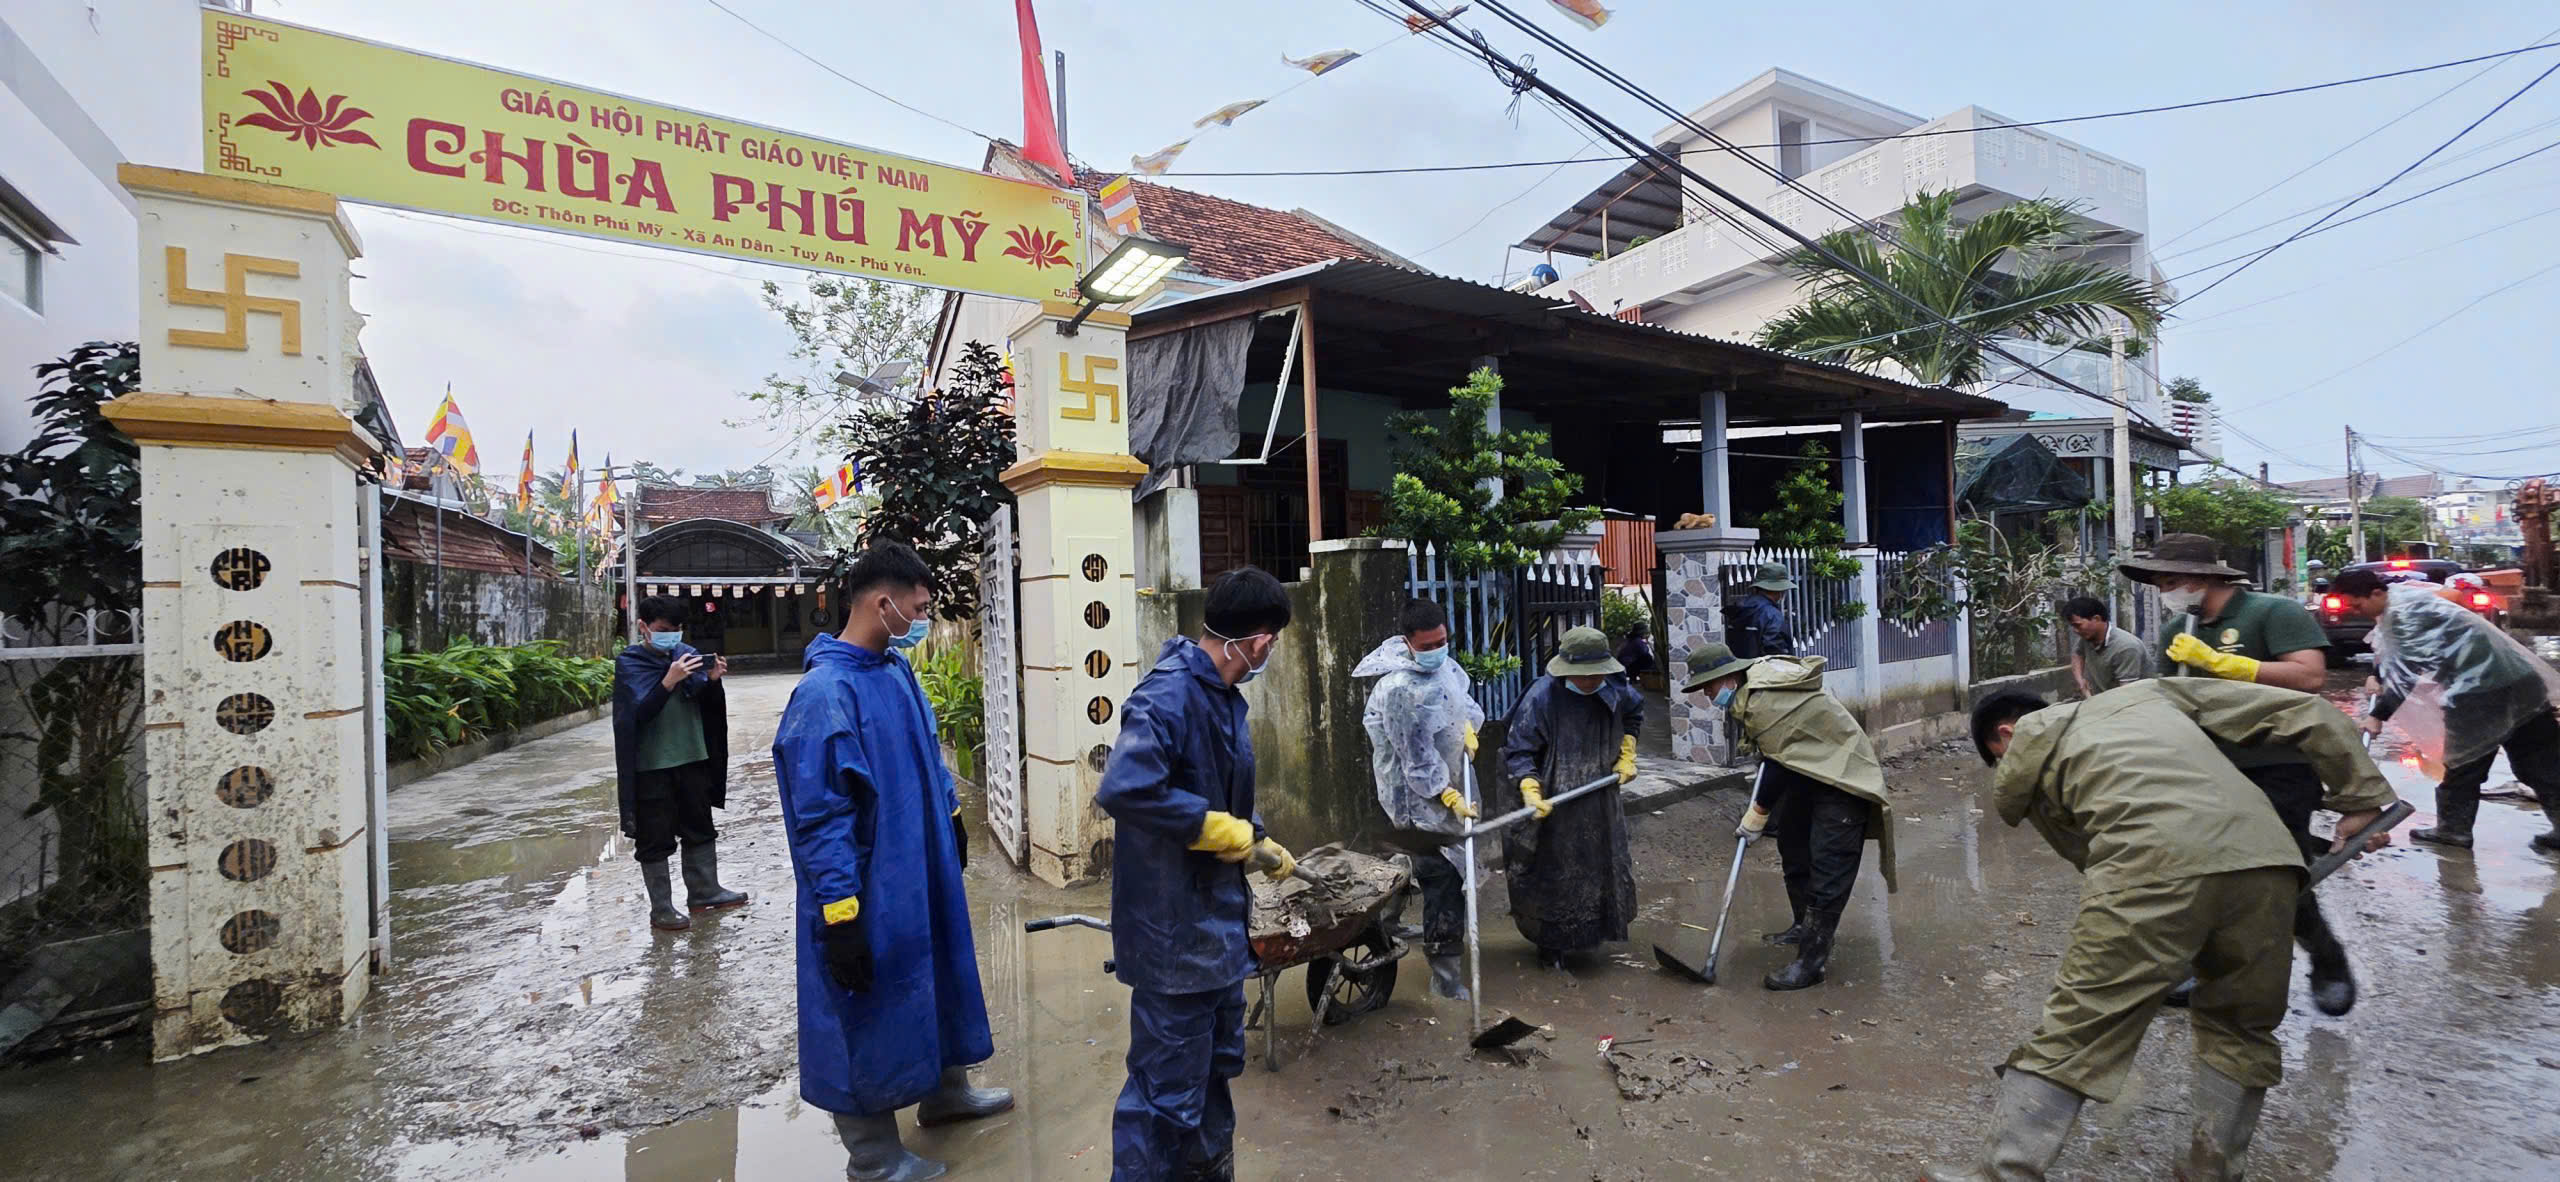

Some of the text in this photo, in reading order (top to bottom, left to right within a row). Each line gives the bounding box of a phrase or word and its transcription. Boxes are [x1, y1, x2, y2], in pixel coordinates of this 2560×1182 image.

[406, 117, 990, 263] CHÙA PHÚ MỸ
[500, 88, 929, 193] GIÁO HỘI PHẬT GIÁO VIỆT NAM
[492, 198, 529, 216] ĐC:
[535, 205, 586, 224] Thôn
[593, 214, 630, 231] Phú
[637, 221, 664, 238] Mỹ
[684, 228, 706, 243] Xã
[712, 233, 735, 247] An
[741, 237, 773, 253] Dân
[790, 245, 819, 262] Tuy
[824, 251, 845, 265] An
[861, 256, 889, 271] Phú
[894, 262, 926, 277] Yên.
